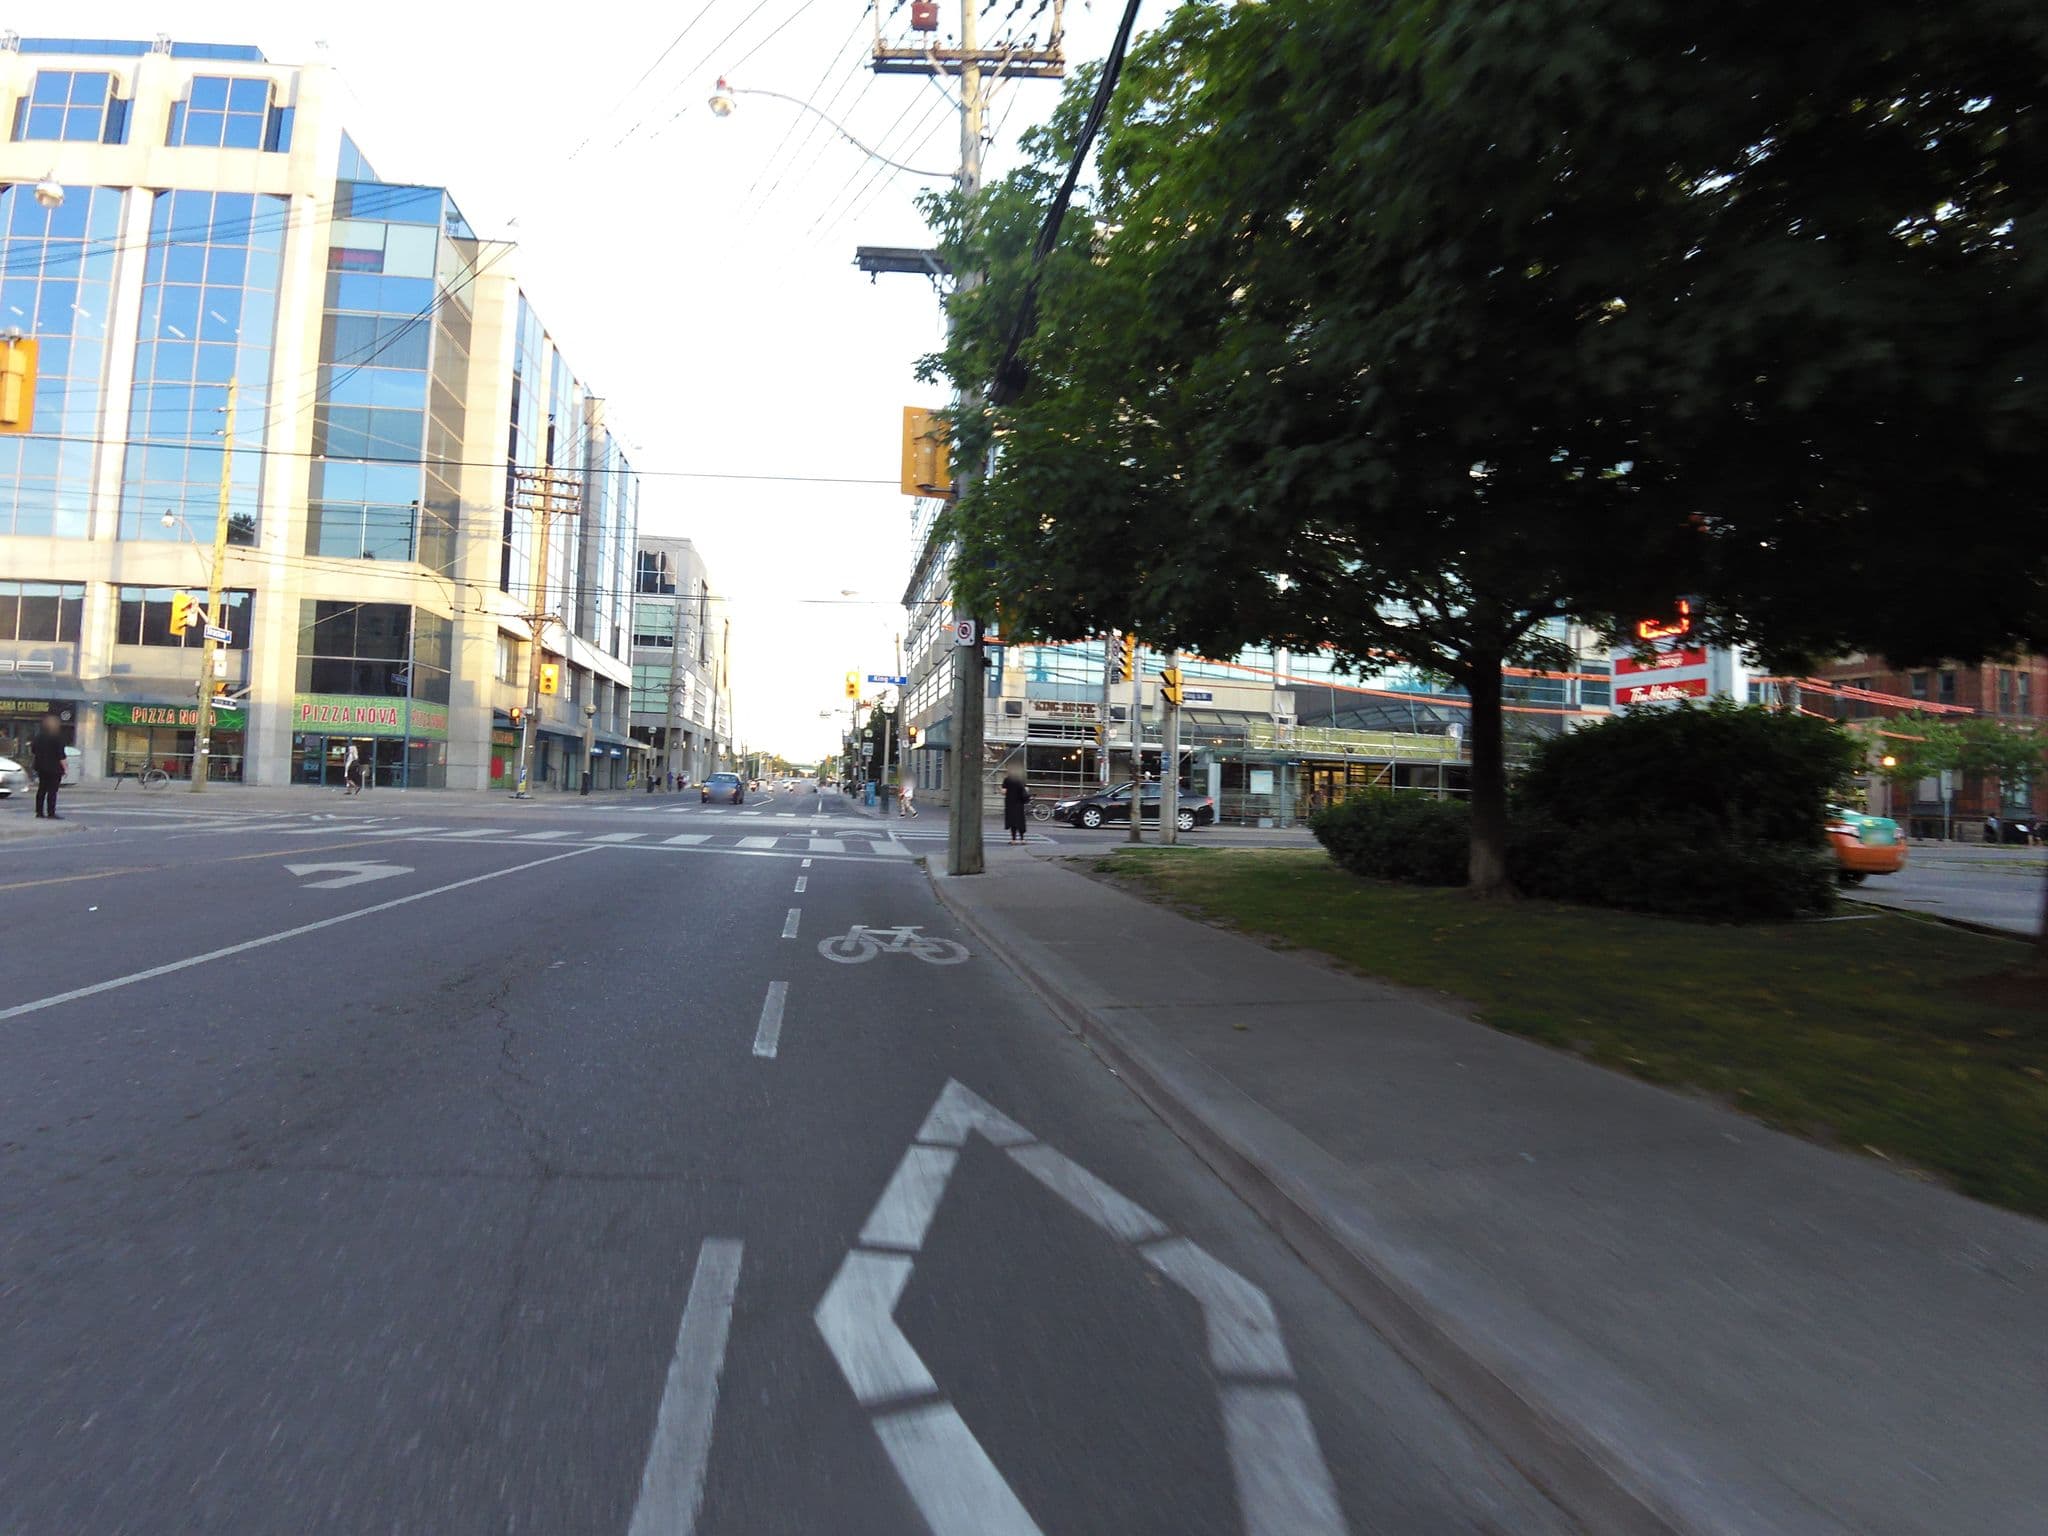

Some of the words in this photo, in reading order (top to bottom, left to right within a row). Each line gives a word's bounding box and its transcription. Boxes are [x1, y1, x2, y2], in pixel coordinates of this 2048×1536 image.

[131, 706, 175, 724] PIZZA
[179, 709, 217, 727] NOA
[301, 703, 350, 722] PIZZA
[356, 707, 398, 727] NOVA
